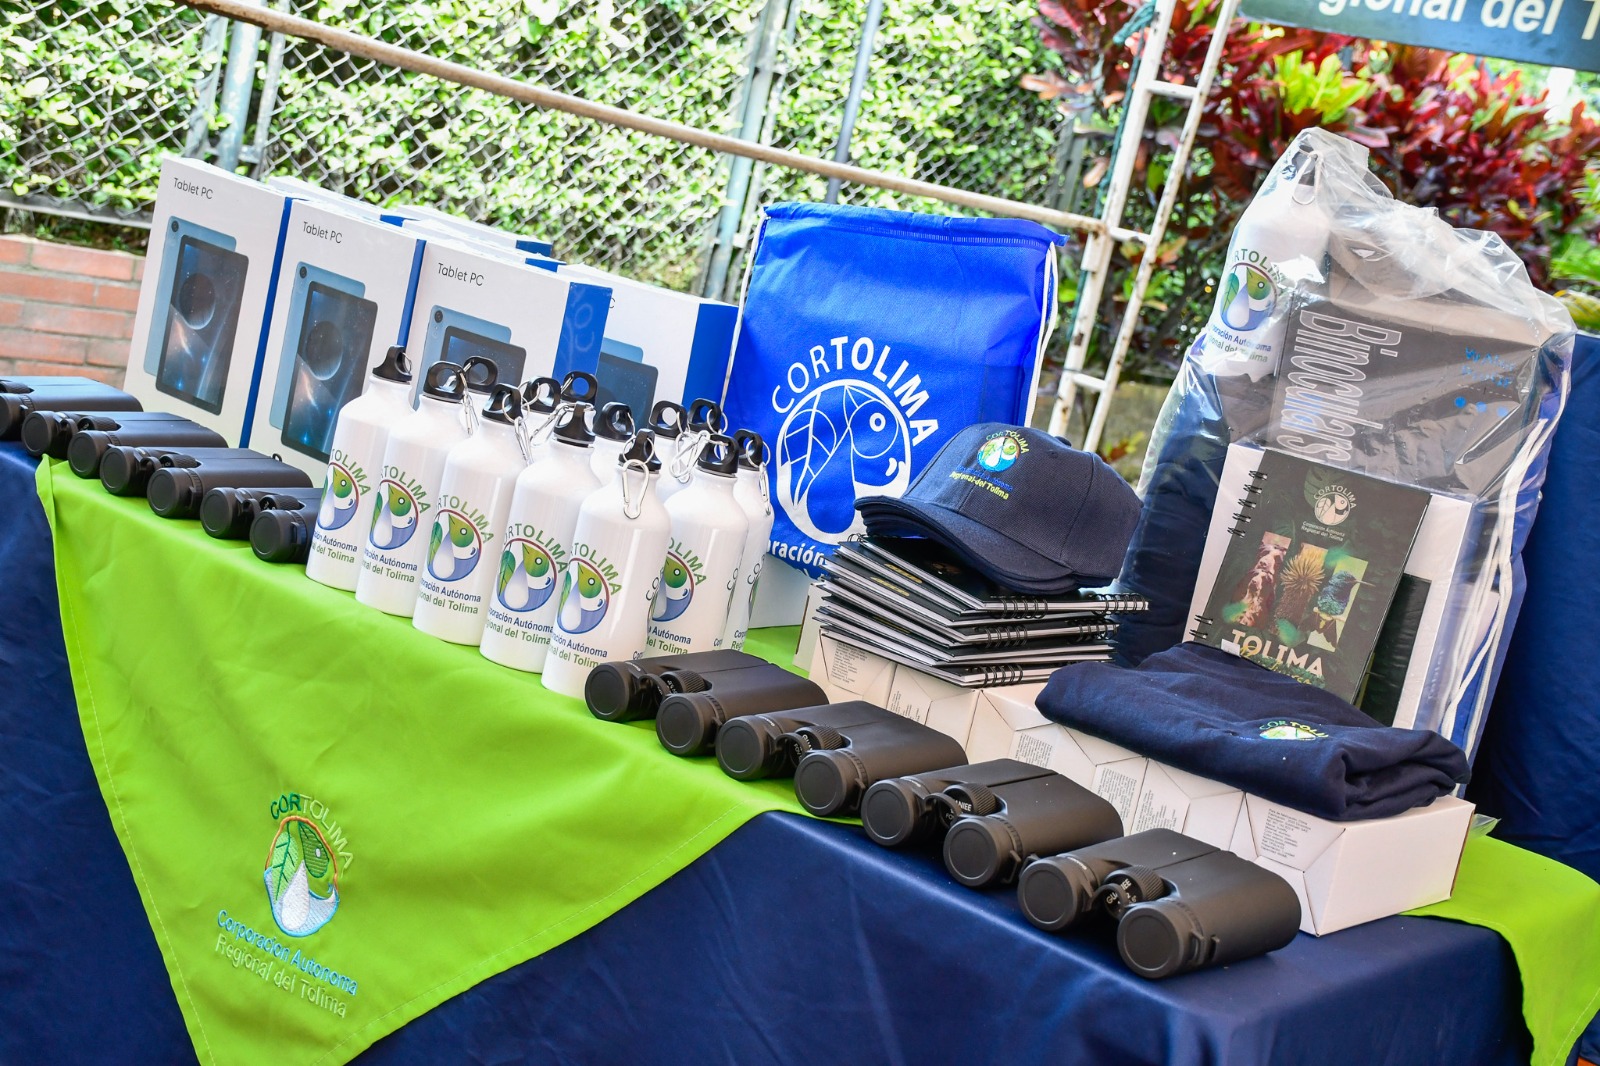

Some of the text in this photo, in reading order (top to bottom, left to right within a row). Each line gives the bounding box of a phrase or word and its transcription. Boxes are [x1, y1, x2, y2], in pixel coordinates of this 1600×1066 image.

[173, 177, 214, 200] Tablet PC
[303, 221, 343, 244] Tablet PC
[438, 263, 484, 287] Tablet PC
[772, 336, 939, 446] CORTOLIMA
[1277, 310, 1401, 461] Binoculars
[381, 465, 432, 514] TOLIMA
[1314, 485, 1356, 508] CORTOLIMA
[322, 535, 358, 552] Autónoma
[327, 547, 355, 563] Tolima
[379, 555, 418, 571] Autónoma
[571, 542, 623, 596] TOLIMA
[385, 567, 415, 583] Tolima
[432, 597, 446, 608] del
[448, 600, 479, 614] Tolima
[440, 586, 482, 602] Autónoma
[504, 627, 519, 638] del
[521, 631, 551, 646] Tolima
[651, 626, 692, 645] Autónoma
[558, 649, 571, 662] del
[573, 653, 599, 669] Tolim
[566, 639, 608, 658] Autónoma
[1232, 629, 1324, 678] TOLIMA
[270, 793, 353, 872] CORTOLIMA
[215, 933, 347, 1019] Regional del Tolima
